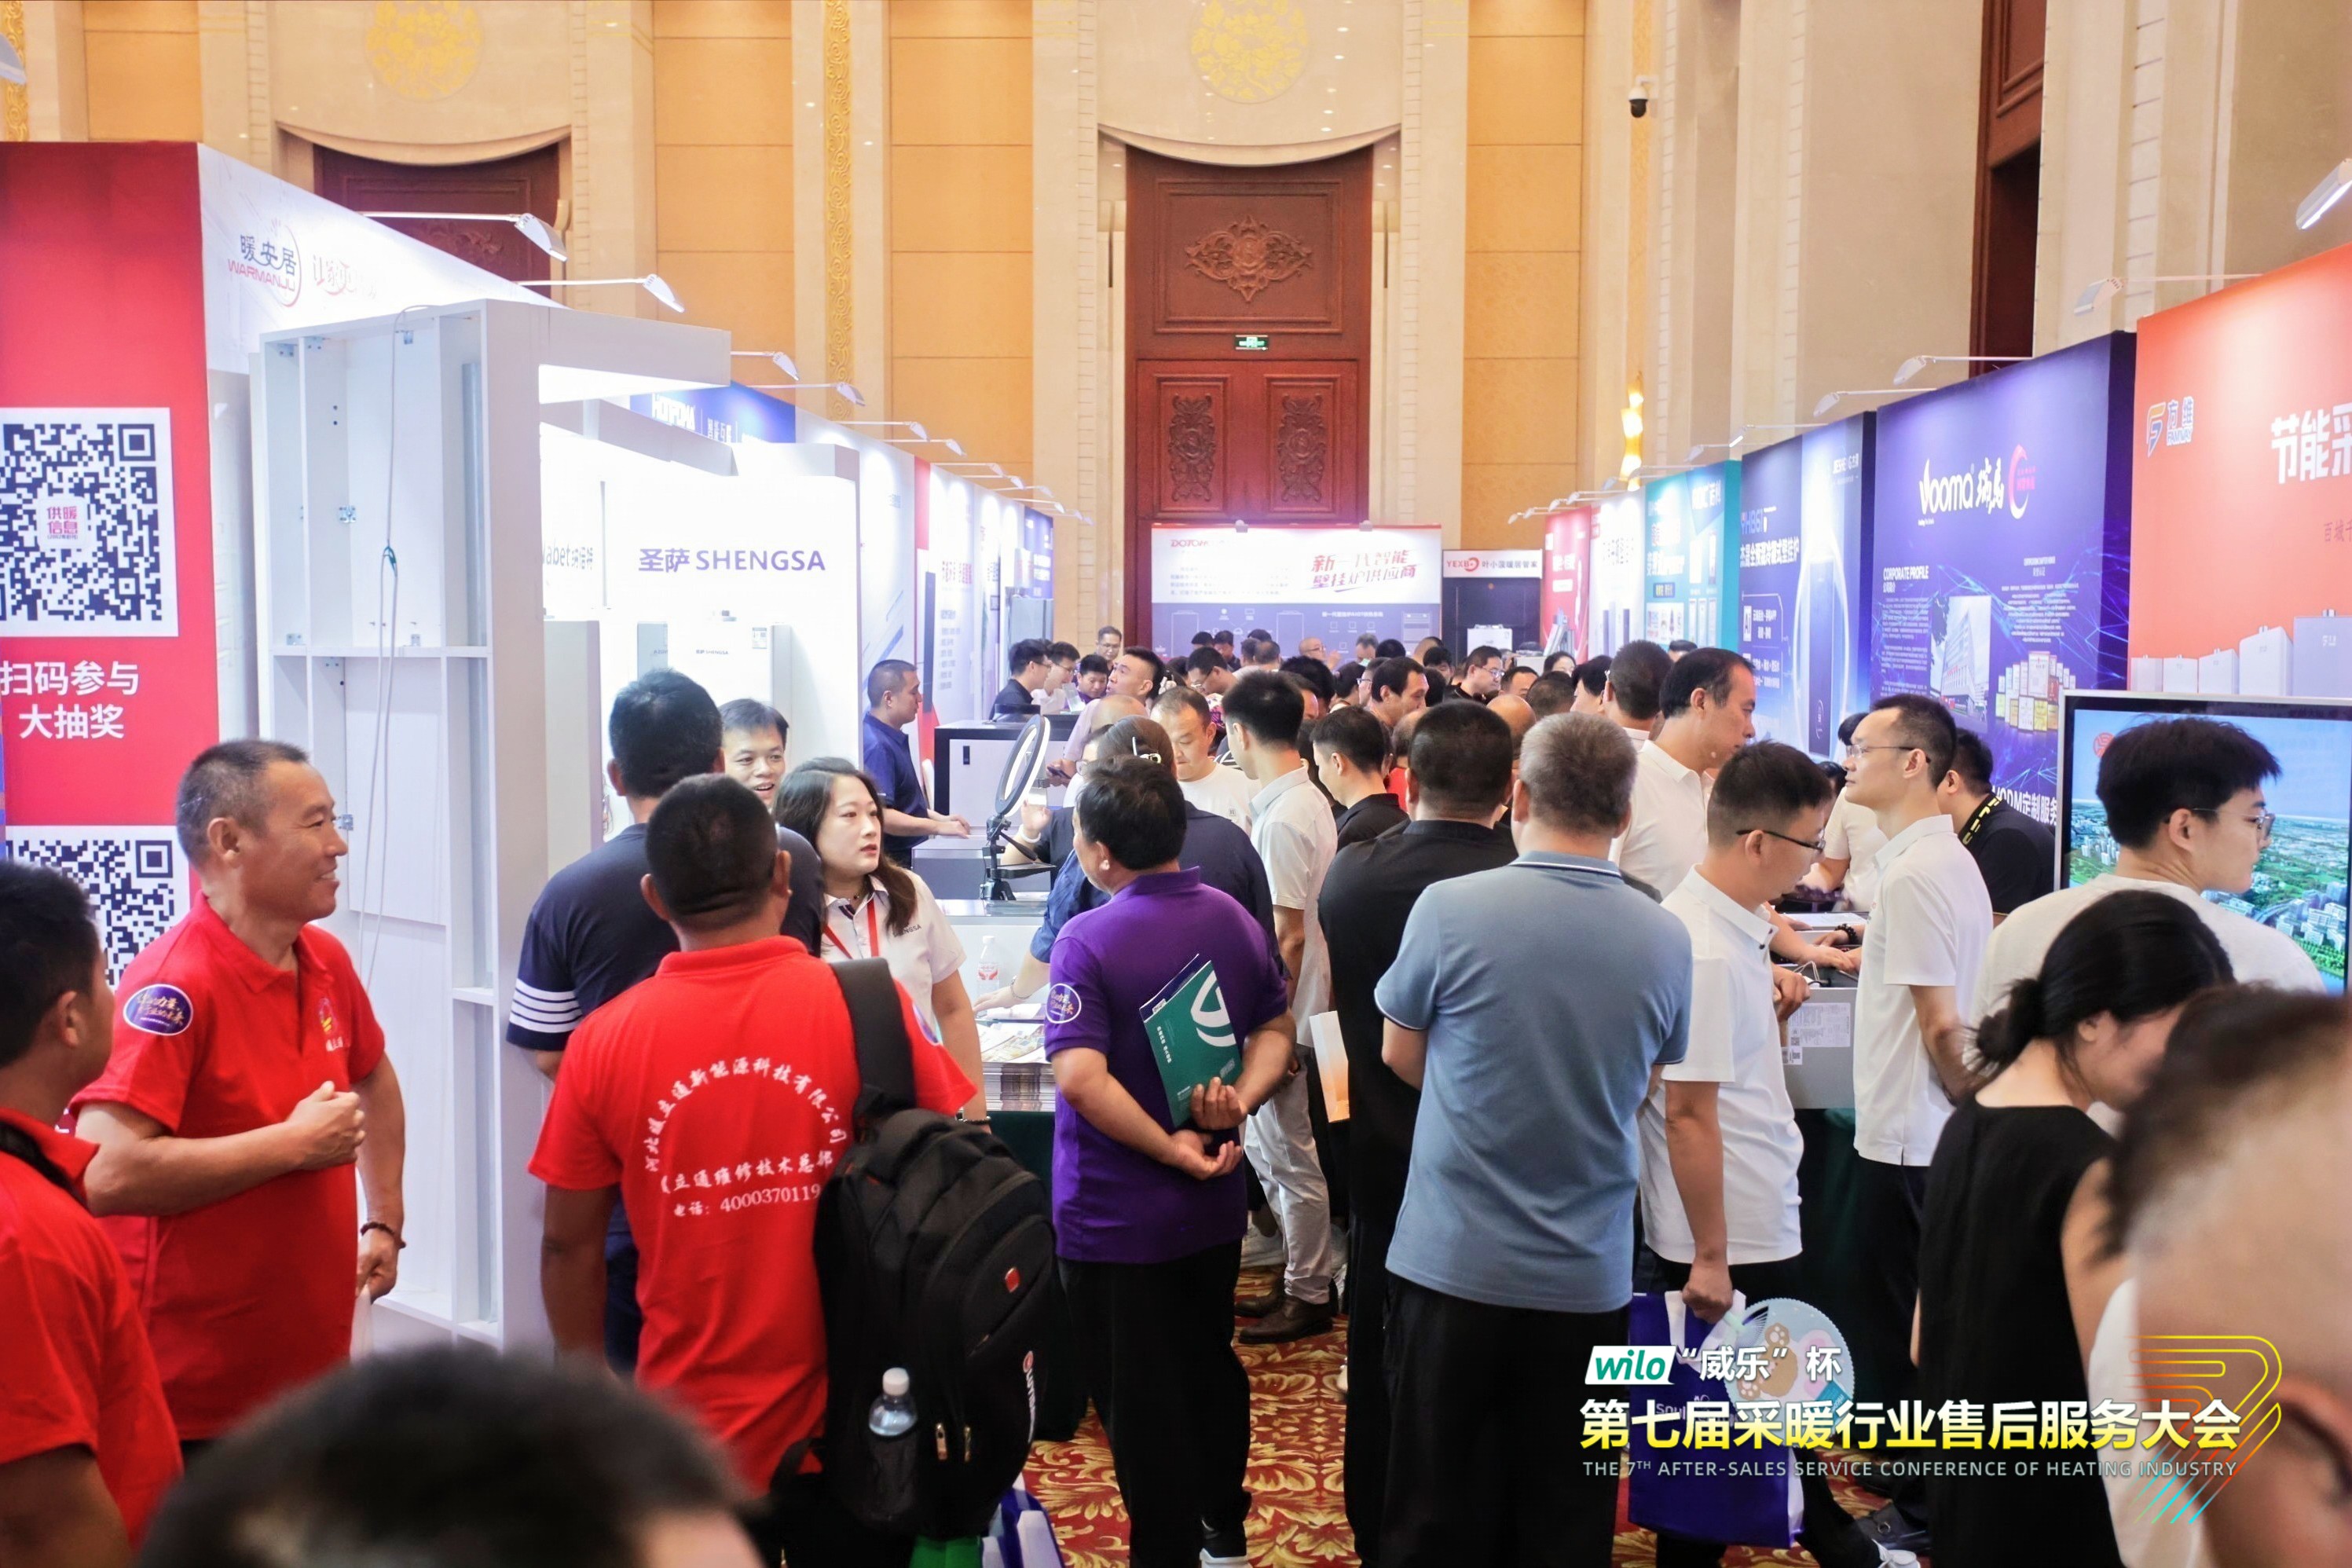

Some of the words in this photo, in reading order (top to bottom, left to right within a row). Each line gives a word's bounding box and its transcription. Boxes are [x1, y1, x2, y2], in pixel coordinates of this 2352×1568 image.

[240, 235, 296, 276] 暖安居
[47, 506, 77, 519] 供暖
[47, 520, 78, 534] 信息
[638, 548, 690, 573] 圣萨
[694, 550, 826, 571] SHENGSA
[1311, 550, 1409, 573] 新一代智能
[1313, 564, 1419, 589] 壁挂炉供应商
[0, 660, 139, 696] 扫码参与
[19, 703, 124, 739] 大抽奖
[720, 1183, 822, 1213] 4000370119
